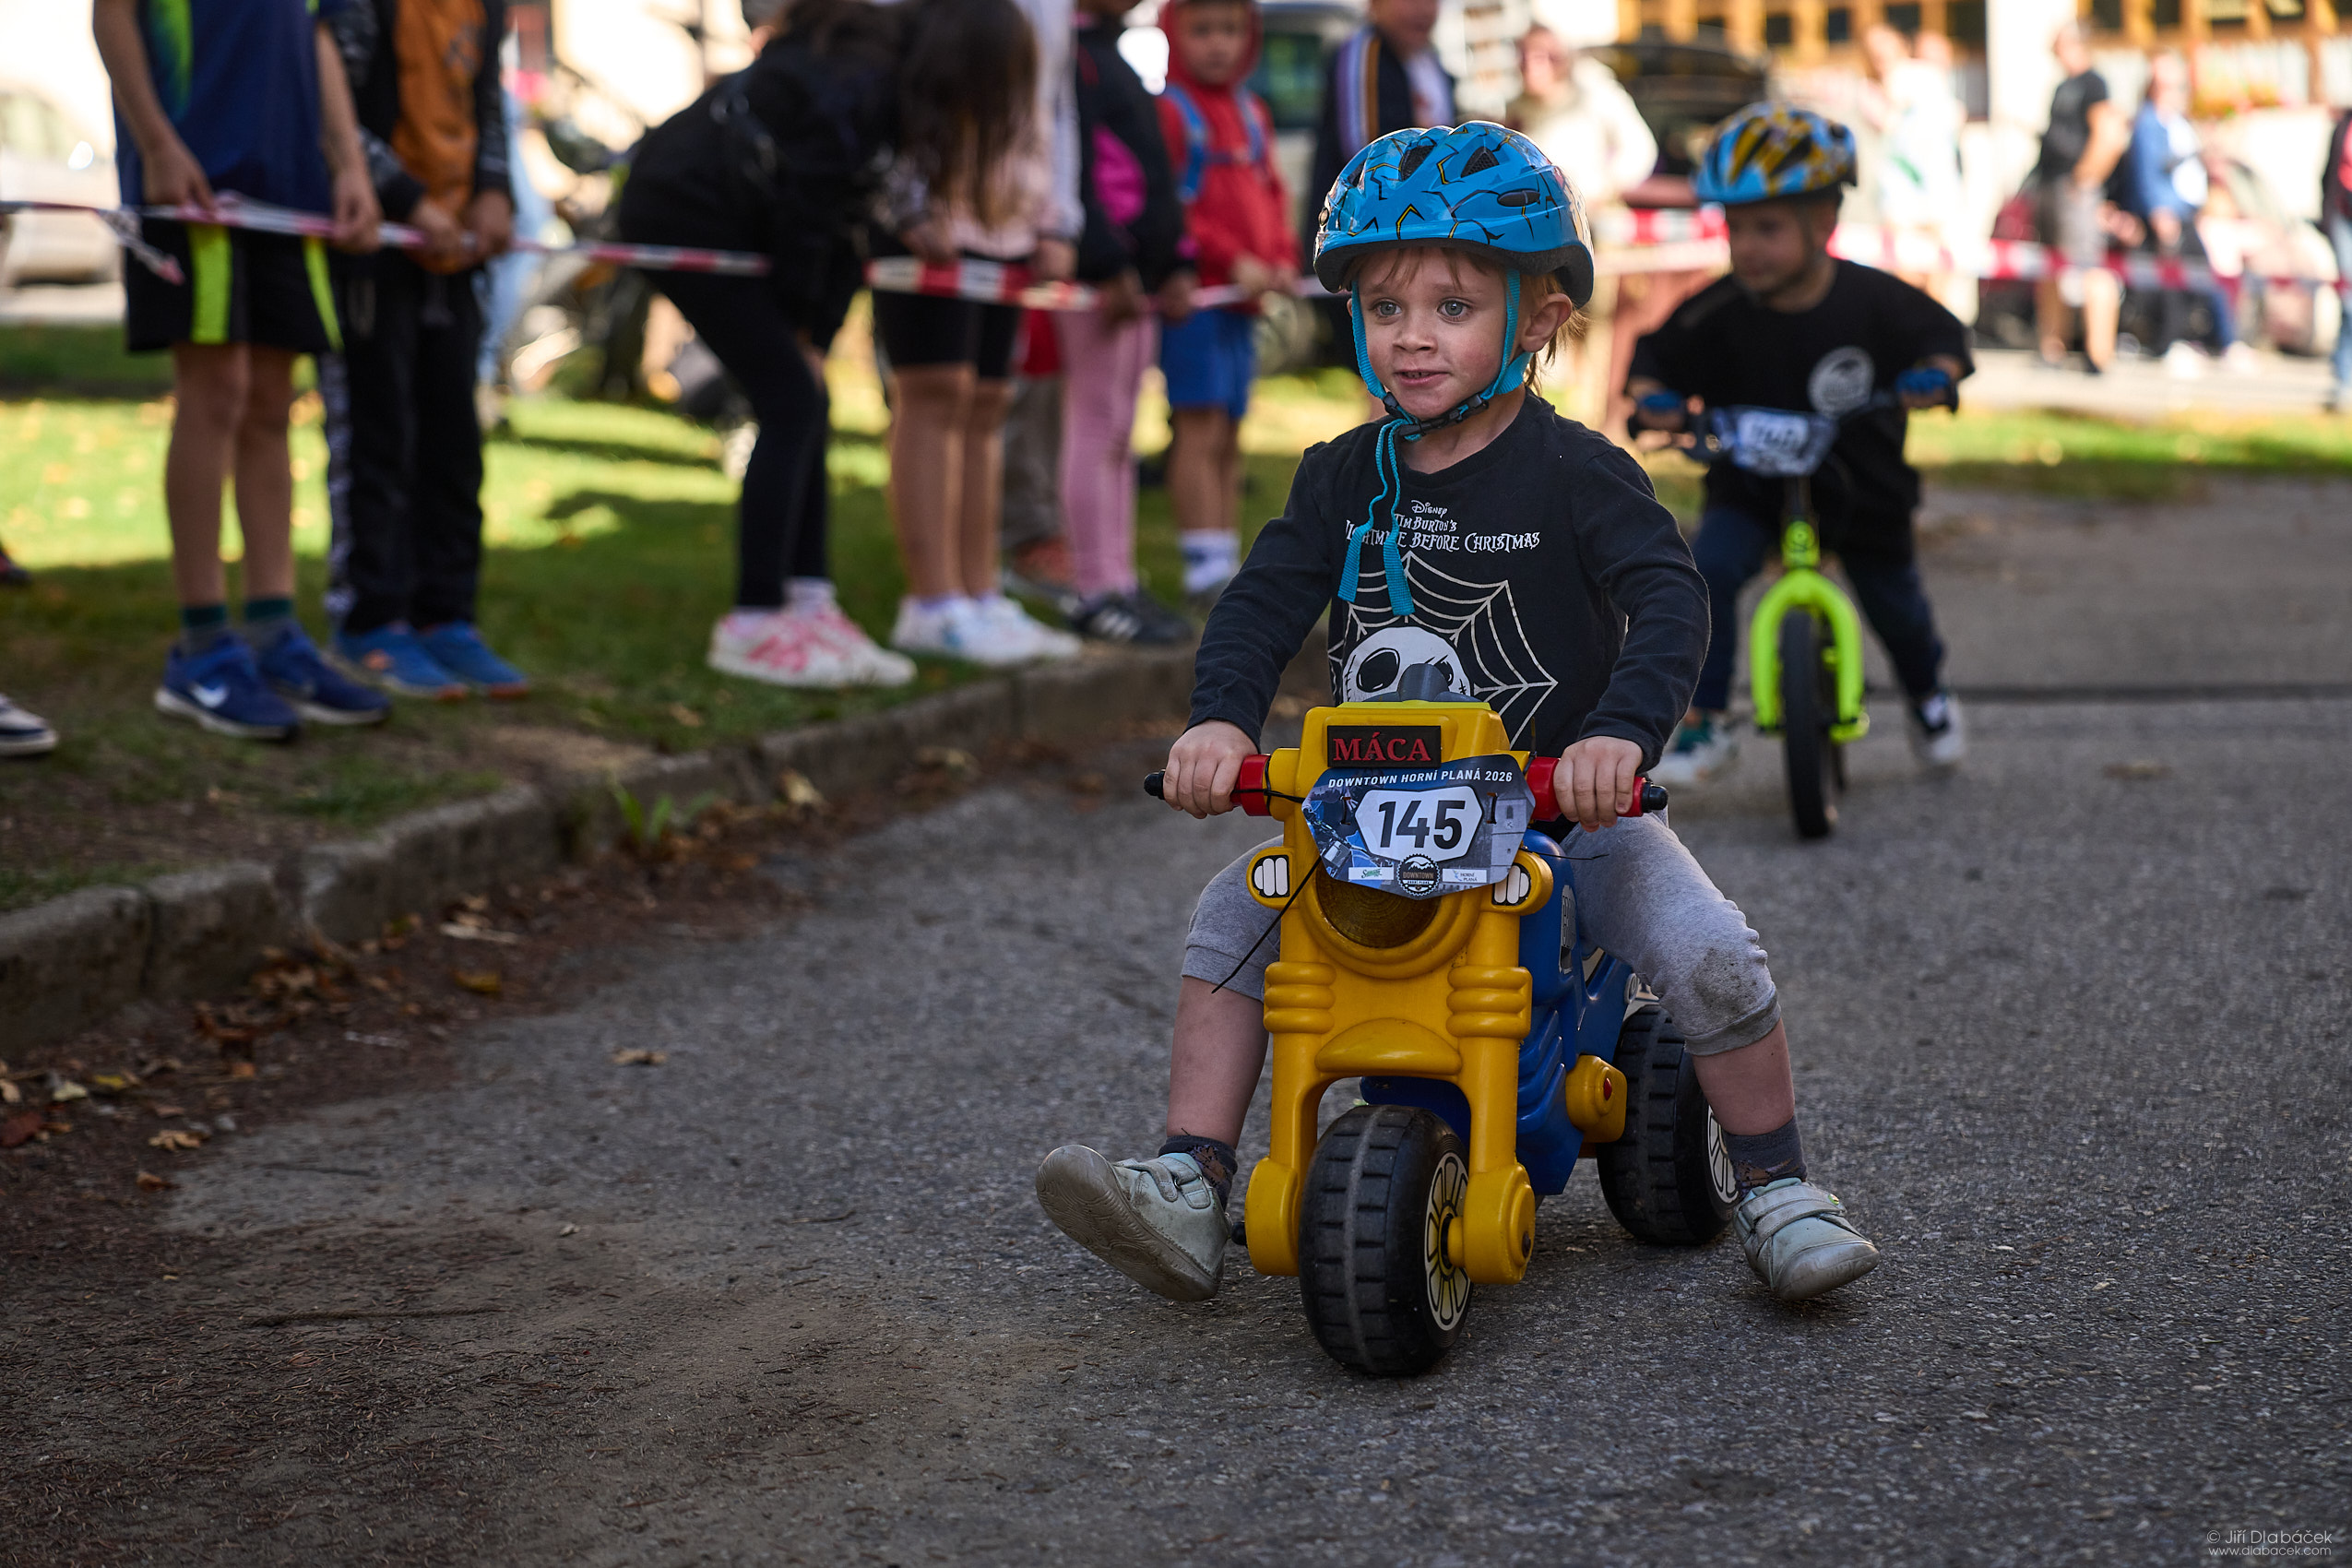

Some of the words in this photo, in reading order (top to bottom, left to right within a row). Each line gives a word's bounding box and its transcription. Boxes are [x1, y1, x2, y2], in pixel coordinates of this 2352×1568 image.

[1409, 532, 1460, 552] BEFORE
[1464, 532, 1540, 553] CHRISTMAS
[1333, 731, 1431, 762] MÁCA
[1328, 774, 1397, 789] DOWNTOWN
[1401, 769, 1438, 784] HORNÍ
[1441, 767, 1481, 781] PLANÁ
[1485, 769, 1513, 782] 2026
[1378, 800, 1467, 849] 145
[1402, 871, 1434, 880] DOWNTOWN
